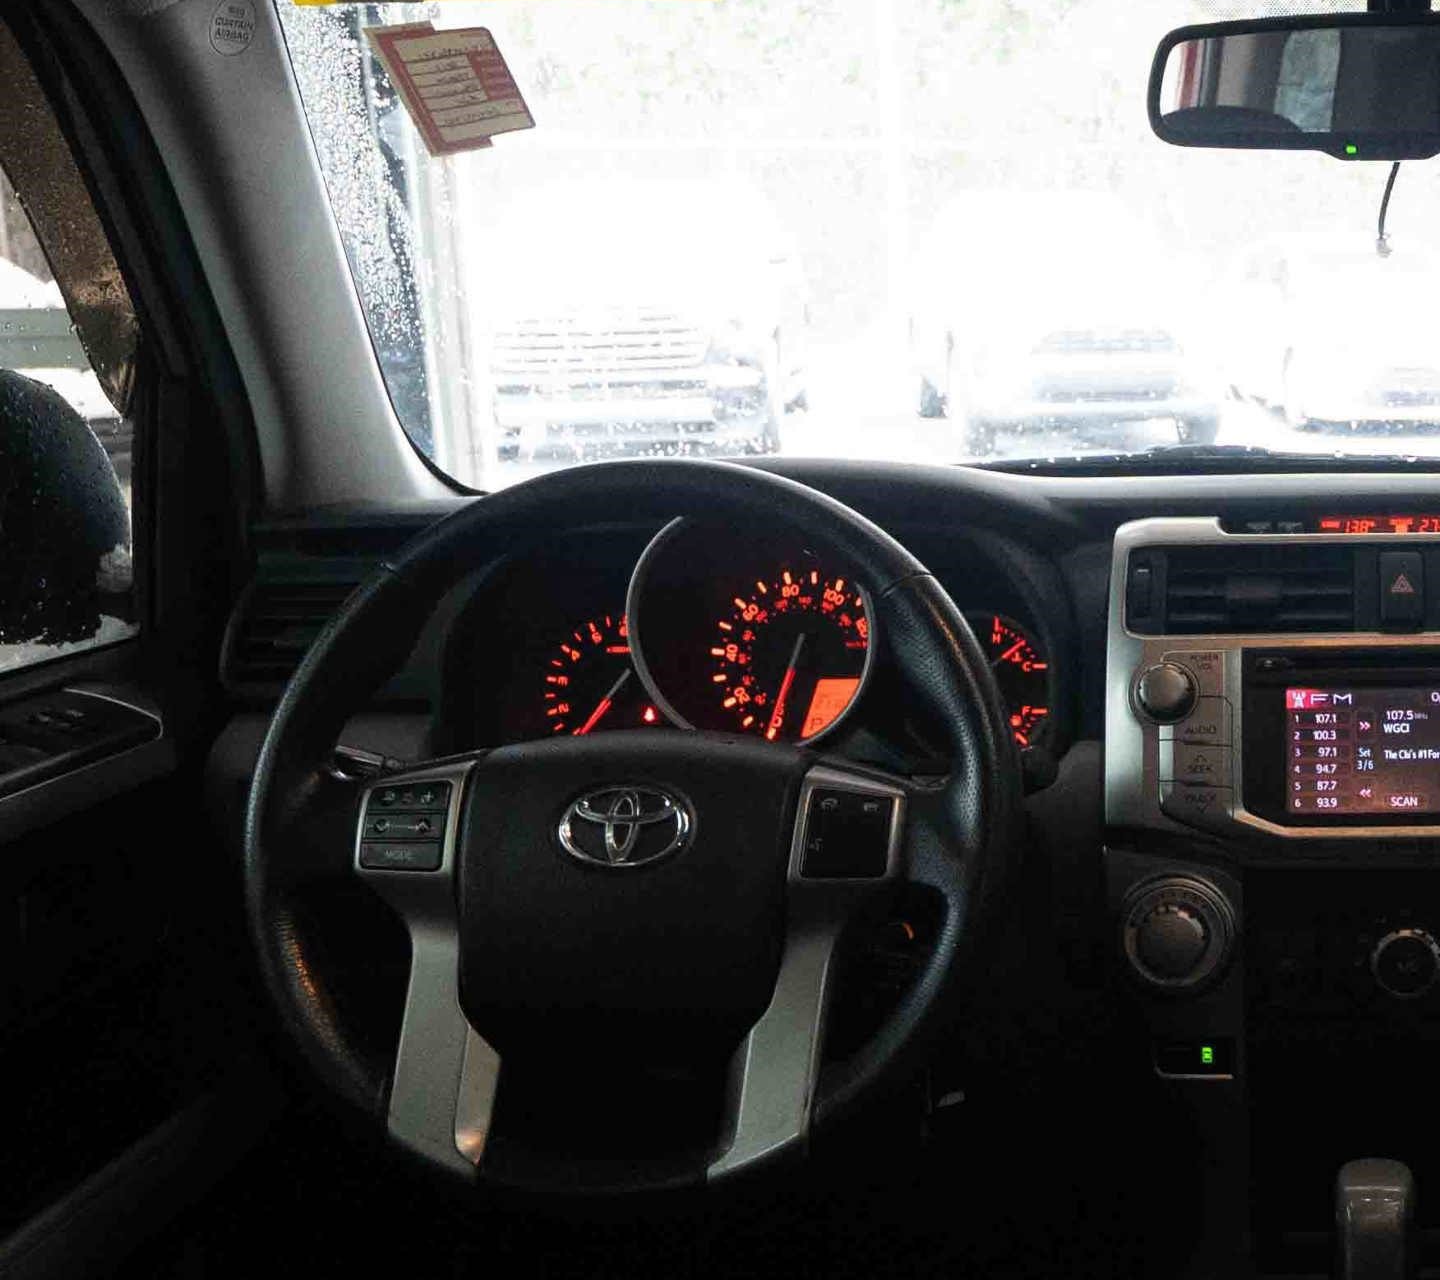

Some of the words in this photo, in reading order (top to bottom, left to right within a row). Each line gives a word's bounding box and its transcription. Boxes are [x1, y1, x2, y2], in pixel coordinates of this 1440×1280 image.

[782, 586, 799, 598] 80
[824, 588, 845, 607] 100
[742, 604, 759, 621] 60
[726, 644, 739, 663] 40
[1314, 713, 1337, 724] 107.1
[1184, 724, 1217, 735] AUDIO
[1312, 730, 1337, 741] 100.3
[1317, 747, 1337, 758] 97.1
[1358, 748, 1372, 759] Set
[1384, 749, 1398, 759] The
[1428, 749, 1440, 759] For
[1315, 764, 1337, 774] 94.7
[1357, 761, 1374, 771] 3/6
[1316, 798, 1338, 808] 93.9
[1390, 797, 1418, 807] SCAN
